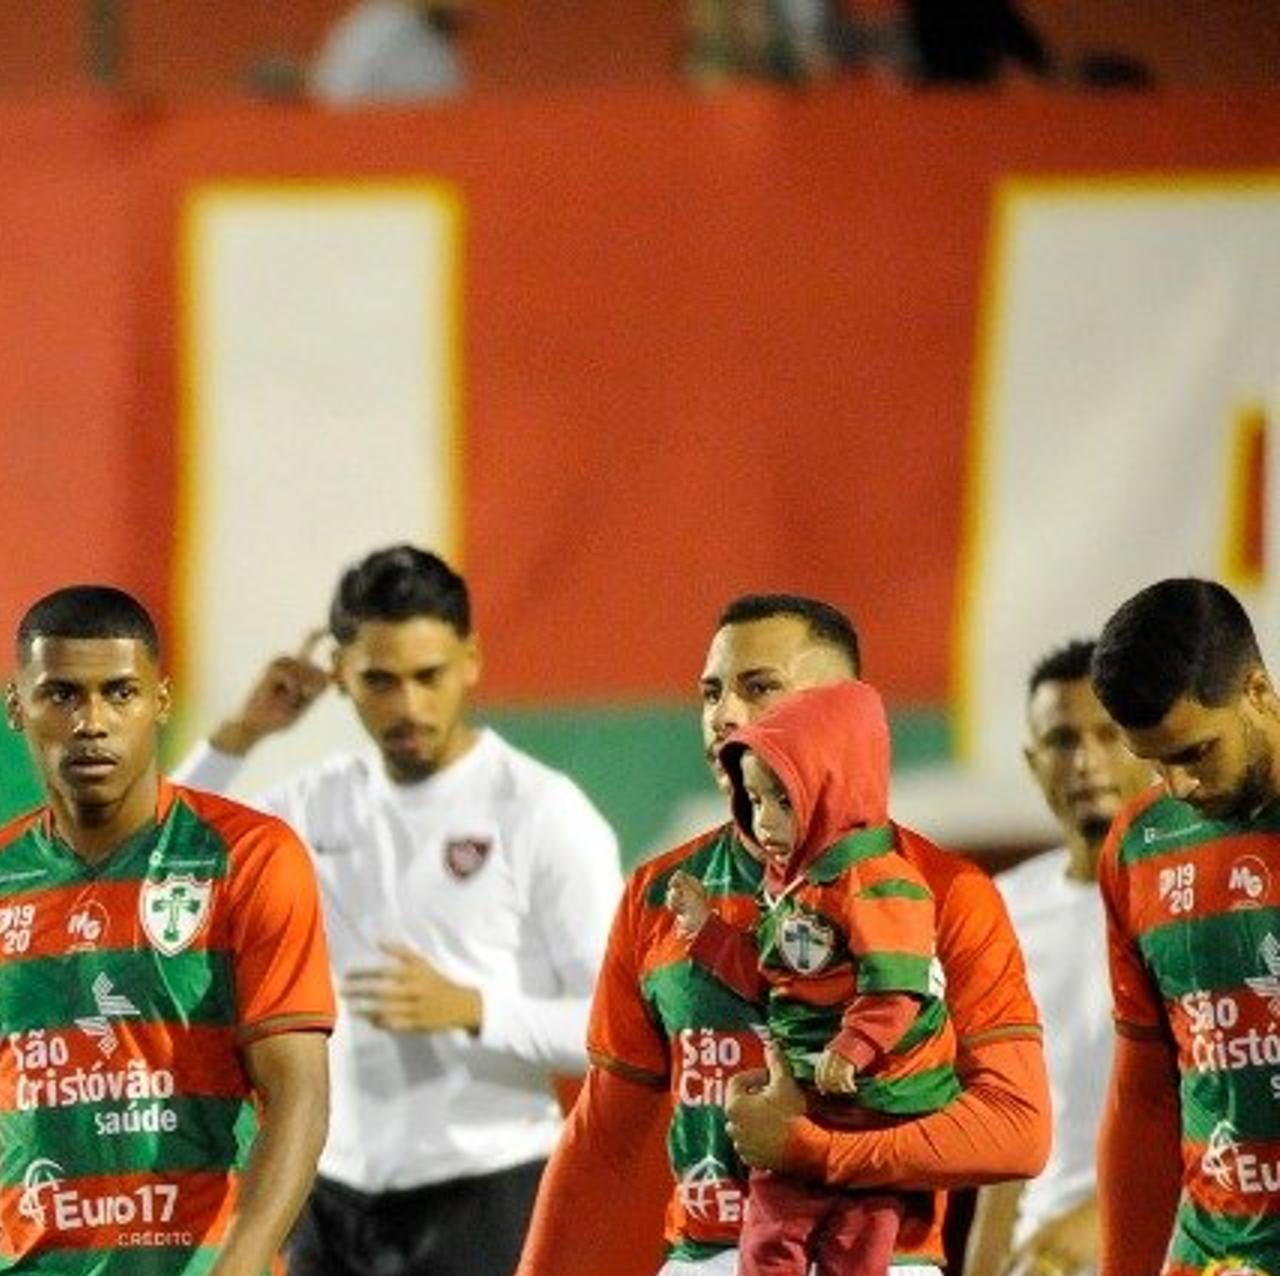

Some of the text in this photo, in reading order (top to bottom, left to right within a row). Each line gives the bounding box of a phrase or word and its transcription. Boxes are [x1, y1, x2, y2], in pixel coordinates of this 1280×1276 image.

[1170, 888, 1194, 914] 20
[4, 930, 31, 955] 20
[9, 1029, 69, 1071] São
[680, 1028, 741, 1068] São
[95, 1100, 178, 1136] saúde
[54, 1184, 179, 1230] Euro17
[118, 1231, 193, 1247] CRÉDITO
